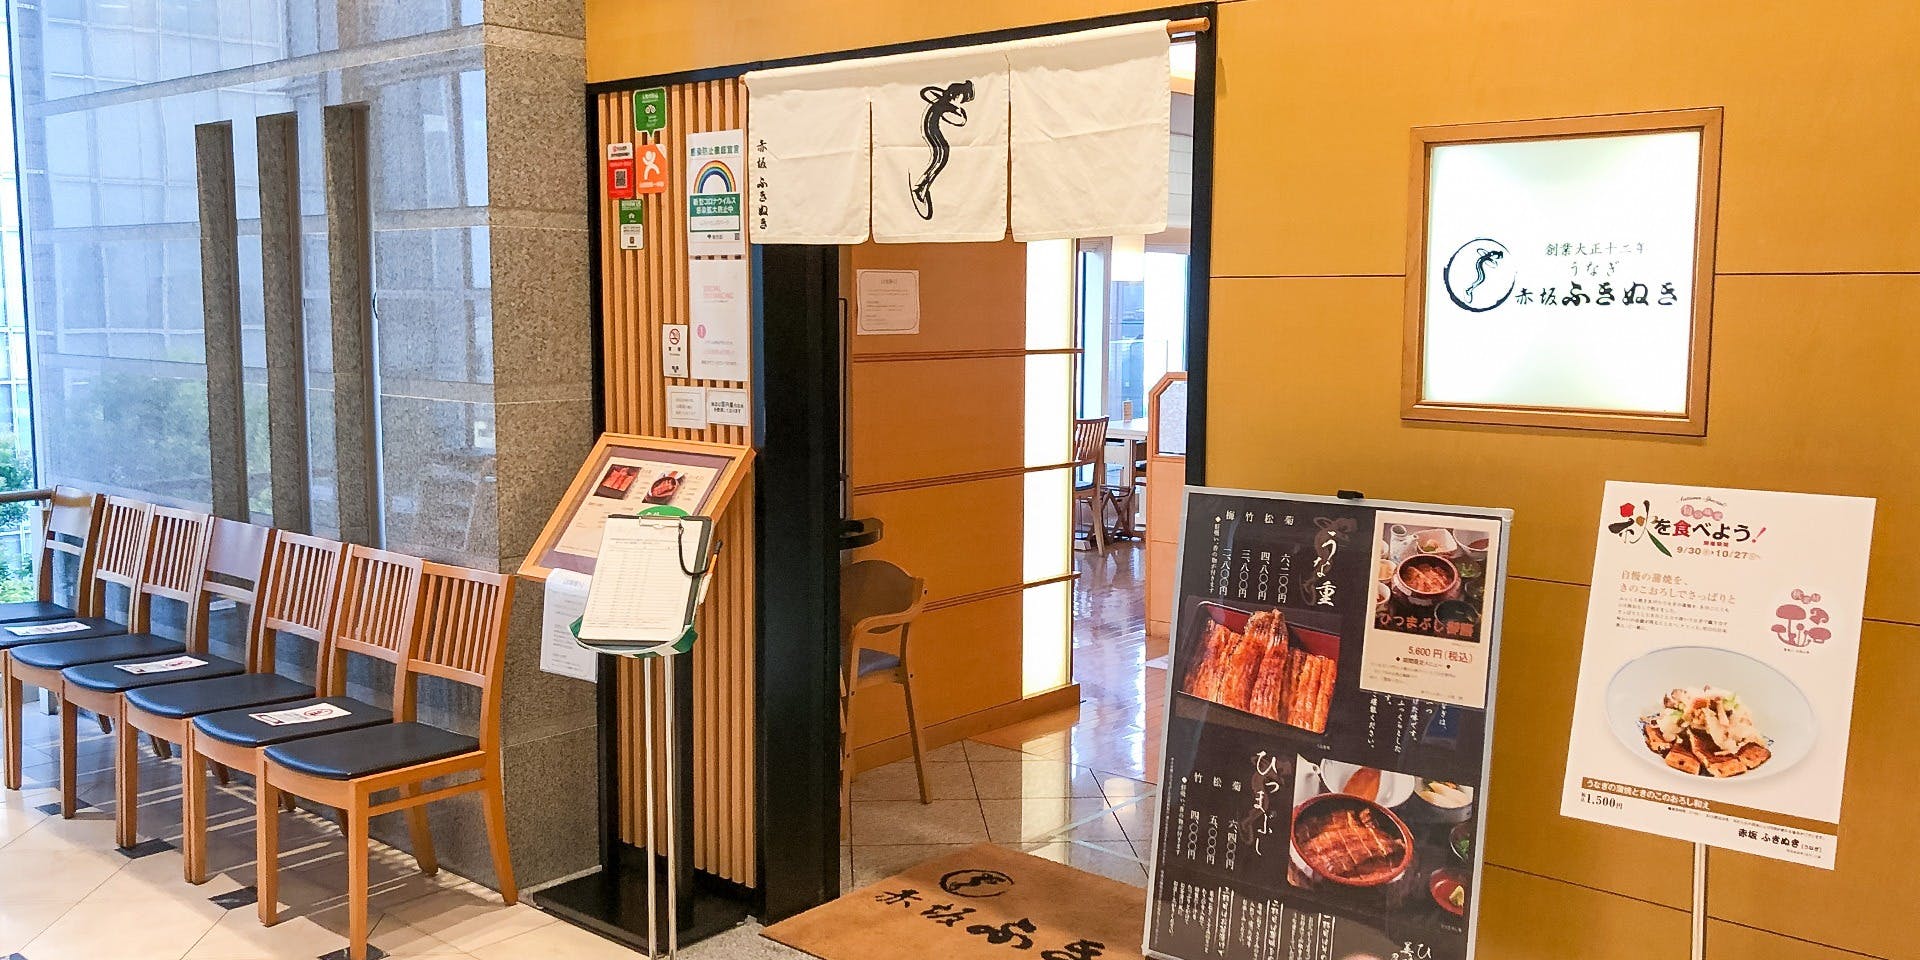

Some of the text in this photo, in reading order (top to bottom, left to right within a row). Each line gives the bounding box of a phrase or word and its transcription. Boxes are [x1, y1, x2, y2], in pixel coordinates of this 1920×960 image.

[1571, 260, 1620, 276] うなぎ
[1245, 511, 1254, 522] 竹
[1313, 531, 1337, 607] うな重
[1194, 772, 1203, 783] 竹
[1253, 751, 1281, 857] ひつまぶし
